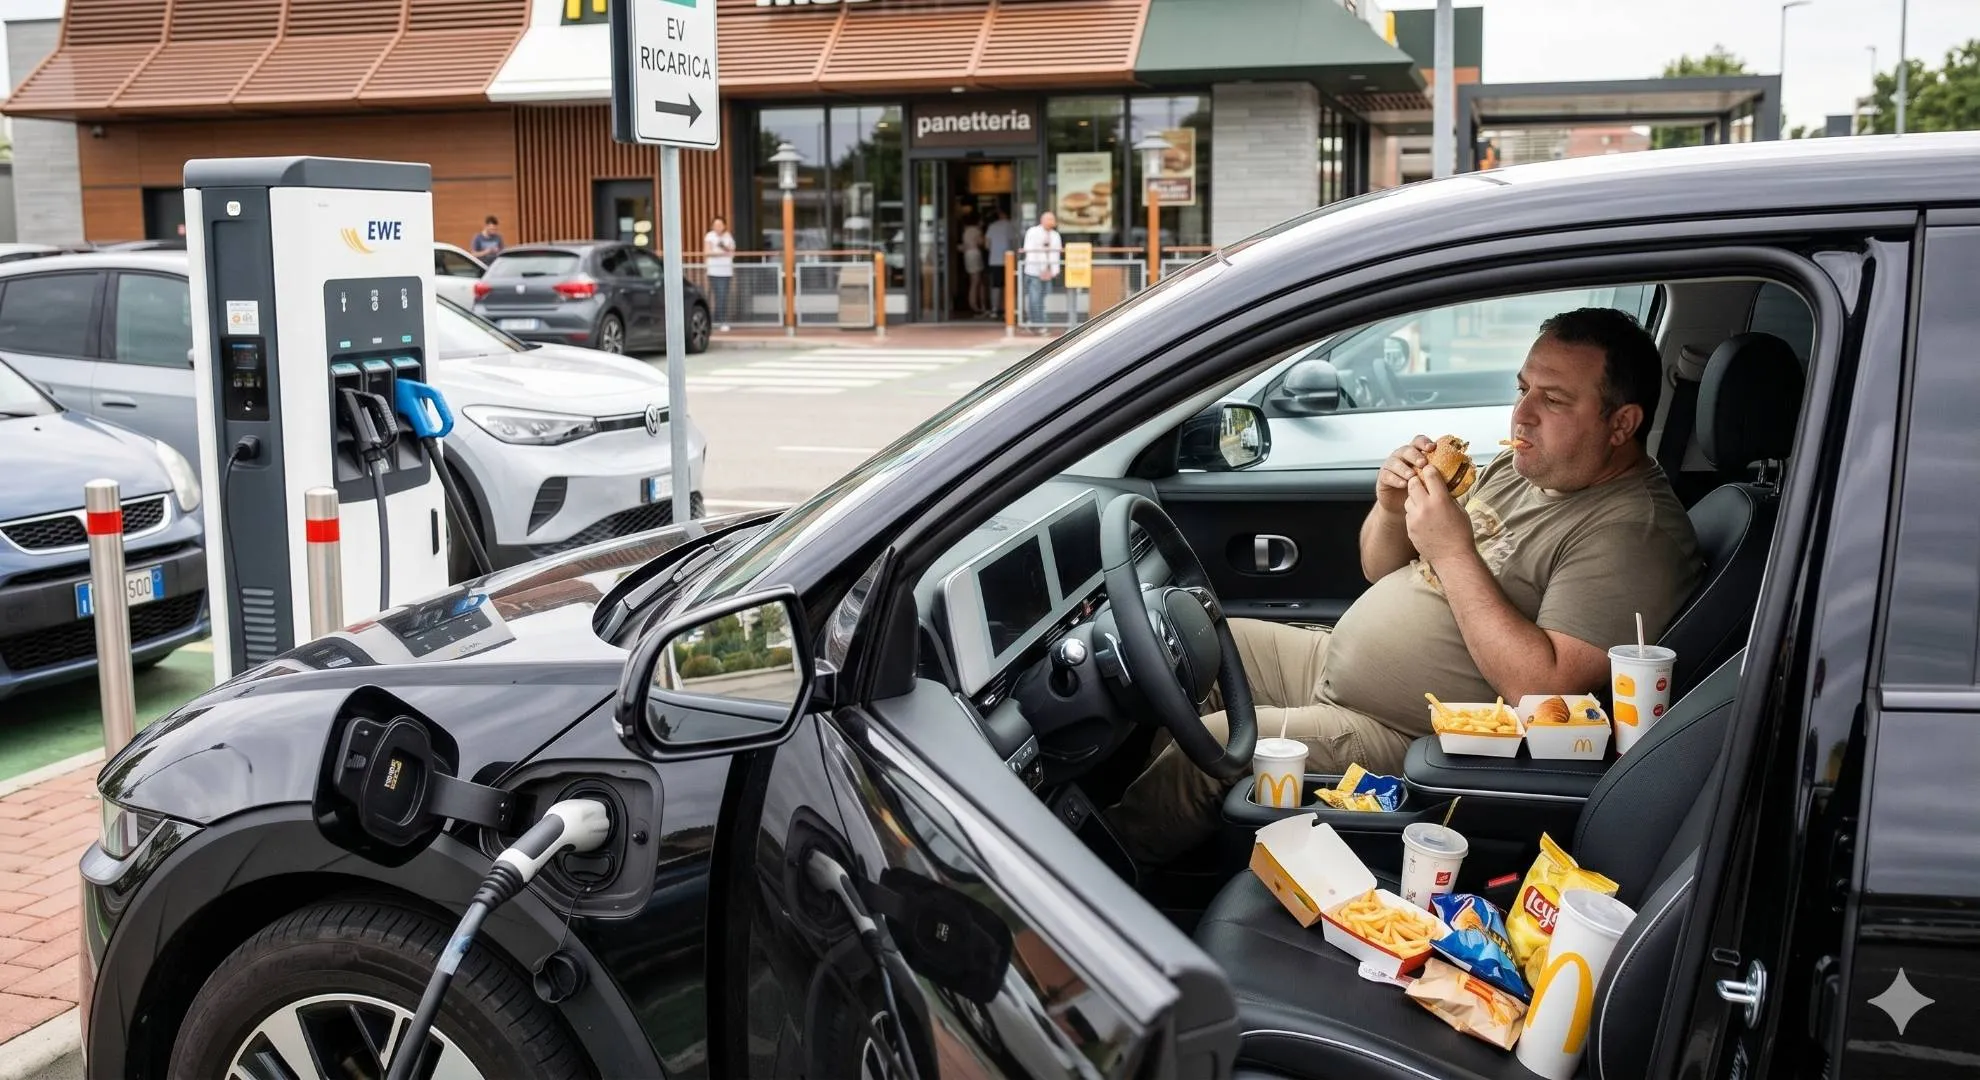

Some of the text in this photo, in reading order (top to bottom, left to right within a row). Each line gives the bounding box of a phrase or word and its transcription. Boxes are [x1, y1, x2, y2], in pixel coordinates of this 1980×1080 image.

[667, 17, 685, 41] EV
[640, 45, 712, 80] RICARICA
[917, 109, 1031, 138] panetteria
[368, 221, 402, 240] EWE
